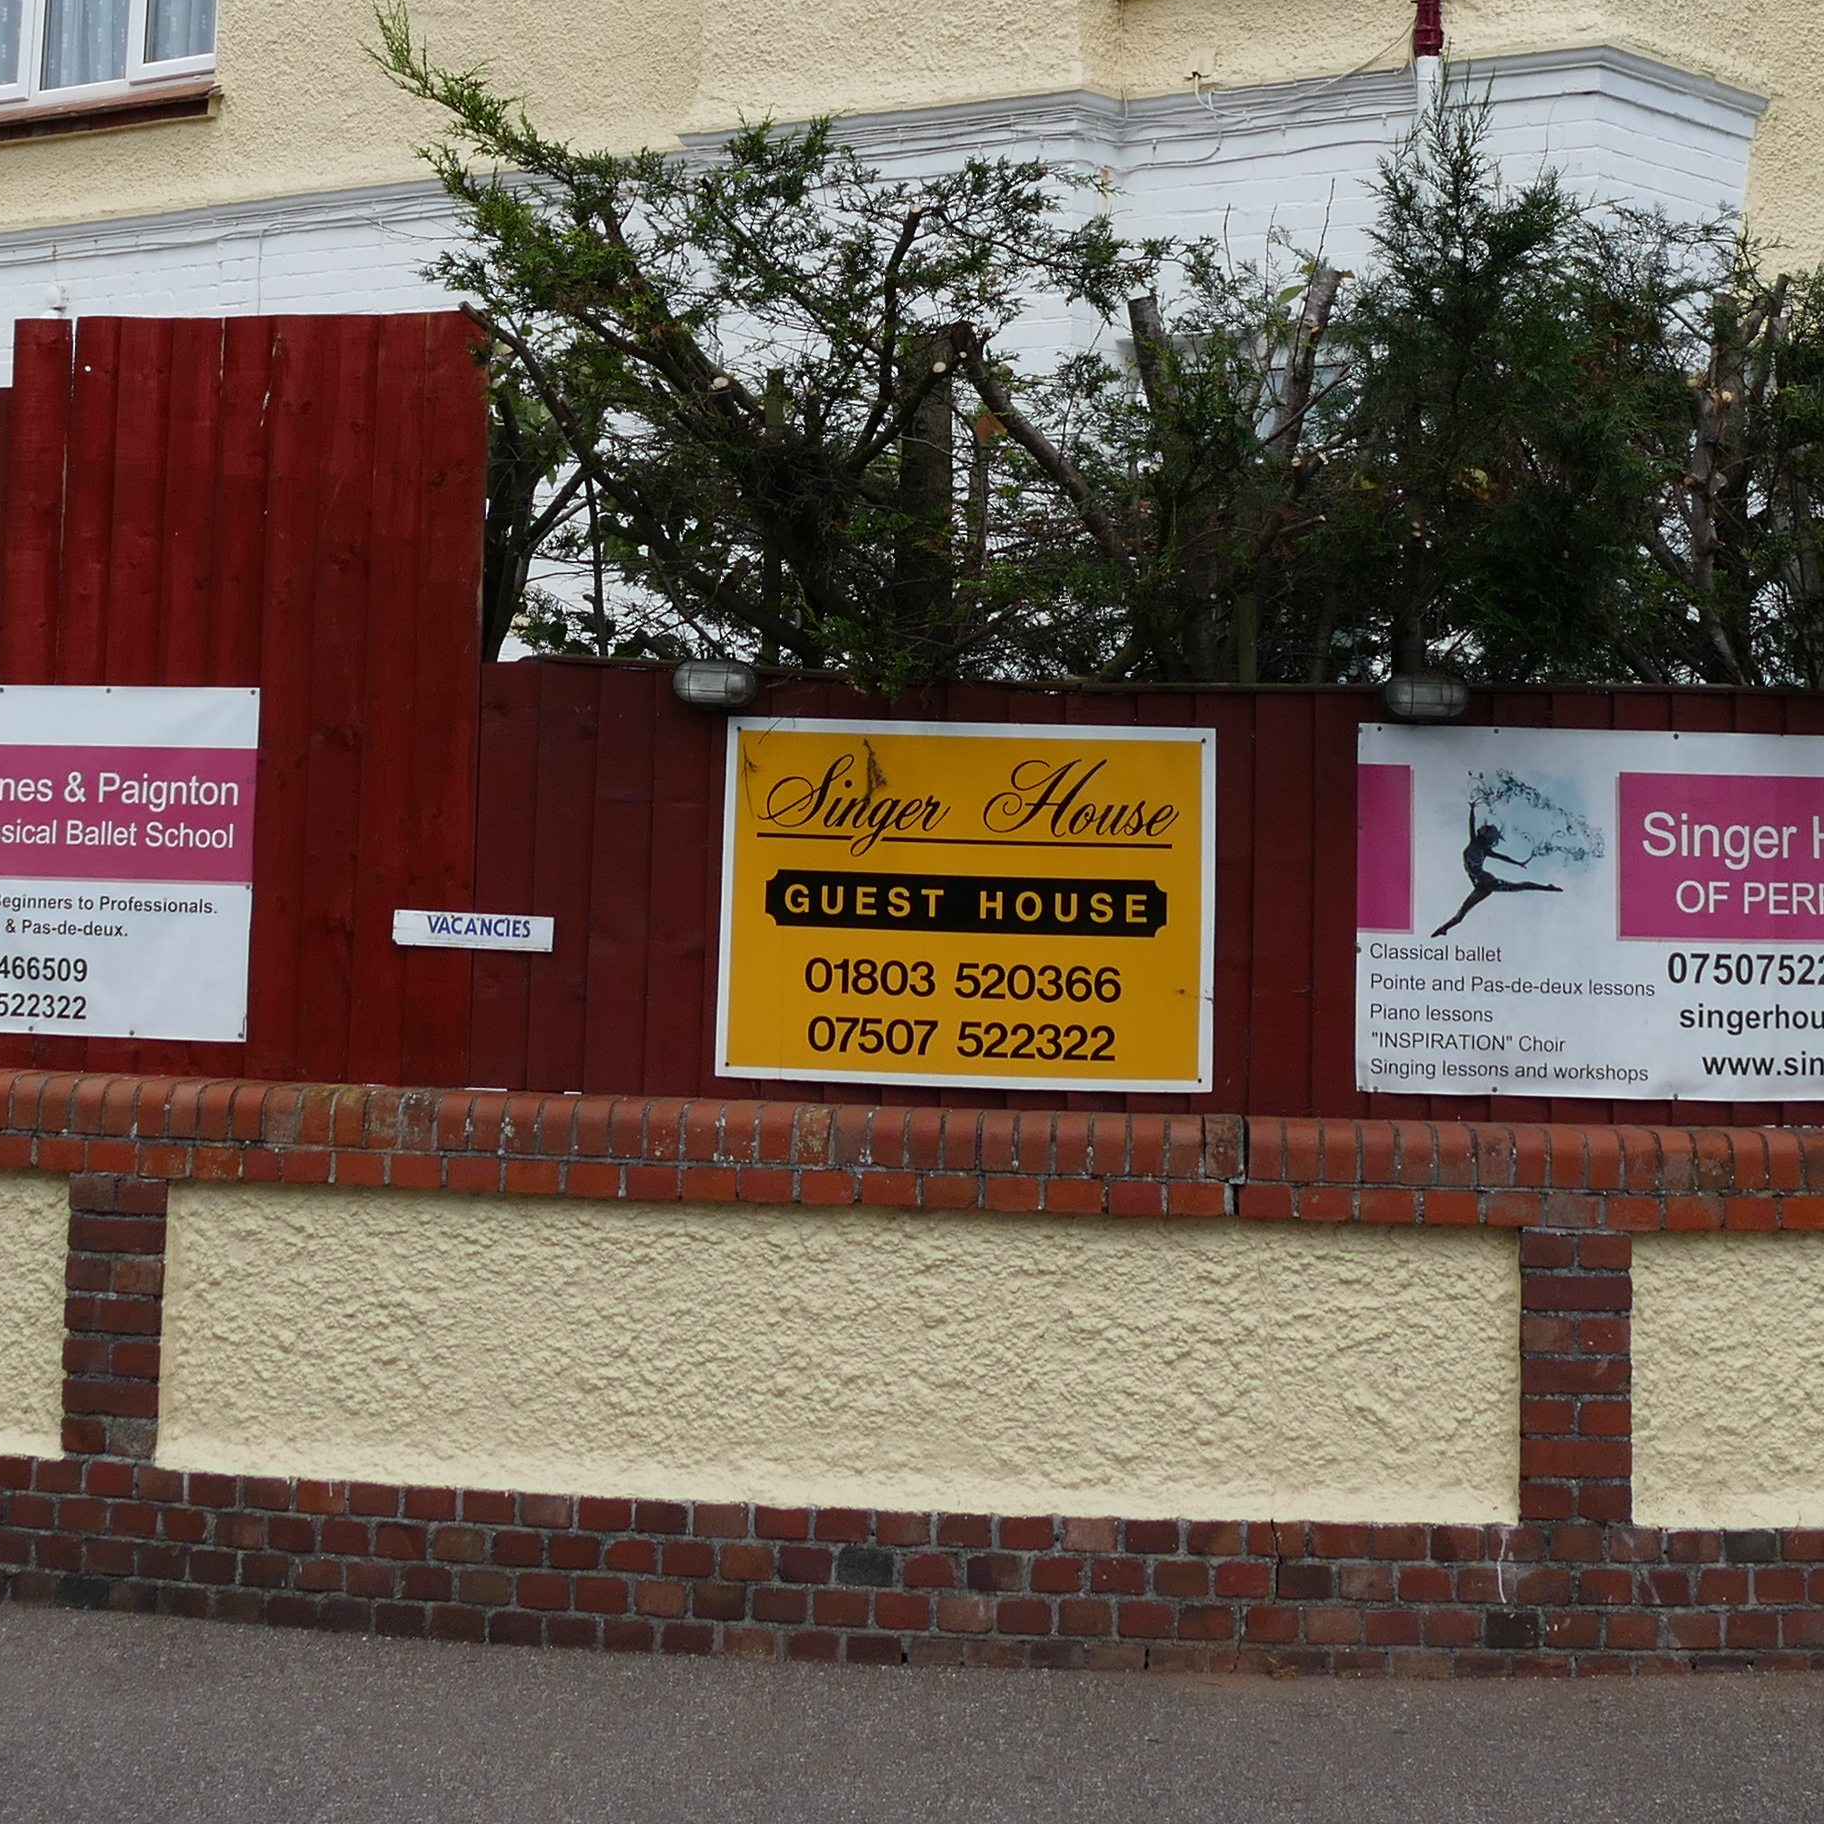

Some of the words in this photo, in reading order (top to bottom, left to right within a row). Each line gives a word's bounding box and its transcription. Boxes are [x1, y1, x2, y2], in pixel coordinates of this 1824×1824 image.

[64, 772, 87, 803] &
[98, 772, 239, 812] Paignton
[757, 753, 951, 857] Singer
[983, 758, 1179, 839] House
[66, 819, 137, 846] Ballet
[145, 821, 234, 849] School
[1642, 811, 1797, 870] Singer
[77, 896, 94, 911] to
[99, 895, 218, 915] Professionals.
[784, 884, 945, 918] GUEST
[979, 889, 1148, 924] HOUSE
[1675, 880, 1730, 915] OF
[5, 918, 17, 934] &
[21, 919, 129, 938] Pas-de-deux.
[427, 915, 531, 938] VACANCIES
[1369, 942, 1449, 962] Classical
[1455, 945, 1502, 963] ballet
[805, 957, 936, 998] 01803
[954, 961, 1122, 1004] 520366
[1370, 974, 1426, 991] Pointe
[1432, 976, 1465, 992] and
[1471, 976, 1583, 995] Pas-de-deux
[1588, 980, 1656, 997] lessons
[1370, 1003, 1420, 1021] Piano
[1426, 1005, 1494, 1023] lessons
[807, 1015, 939, 1056] 07507
[956, 1021, 1116, 1062] 522322
[1371, 1032, 1513, 1052] "INSPIRATION"
[1518, 1035, 1566, 1053] Choir
[1370, 1058, 1436, 1080] Singing
[1442, 1061, 1509, 1078] lessons
[1514, 1063, 1548, 1079] and
[1553, 1064, 1650, 1085] workshops
